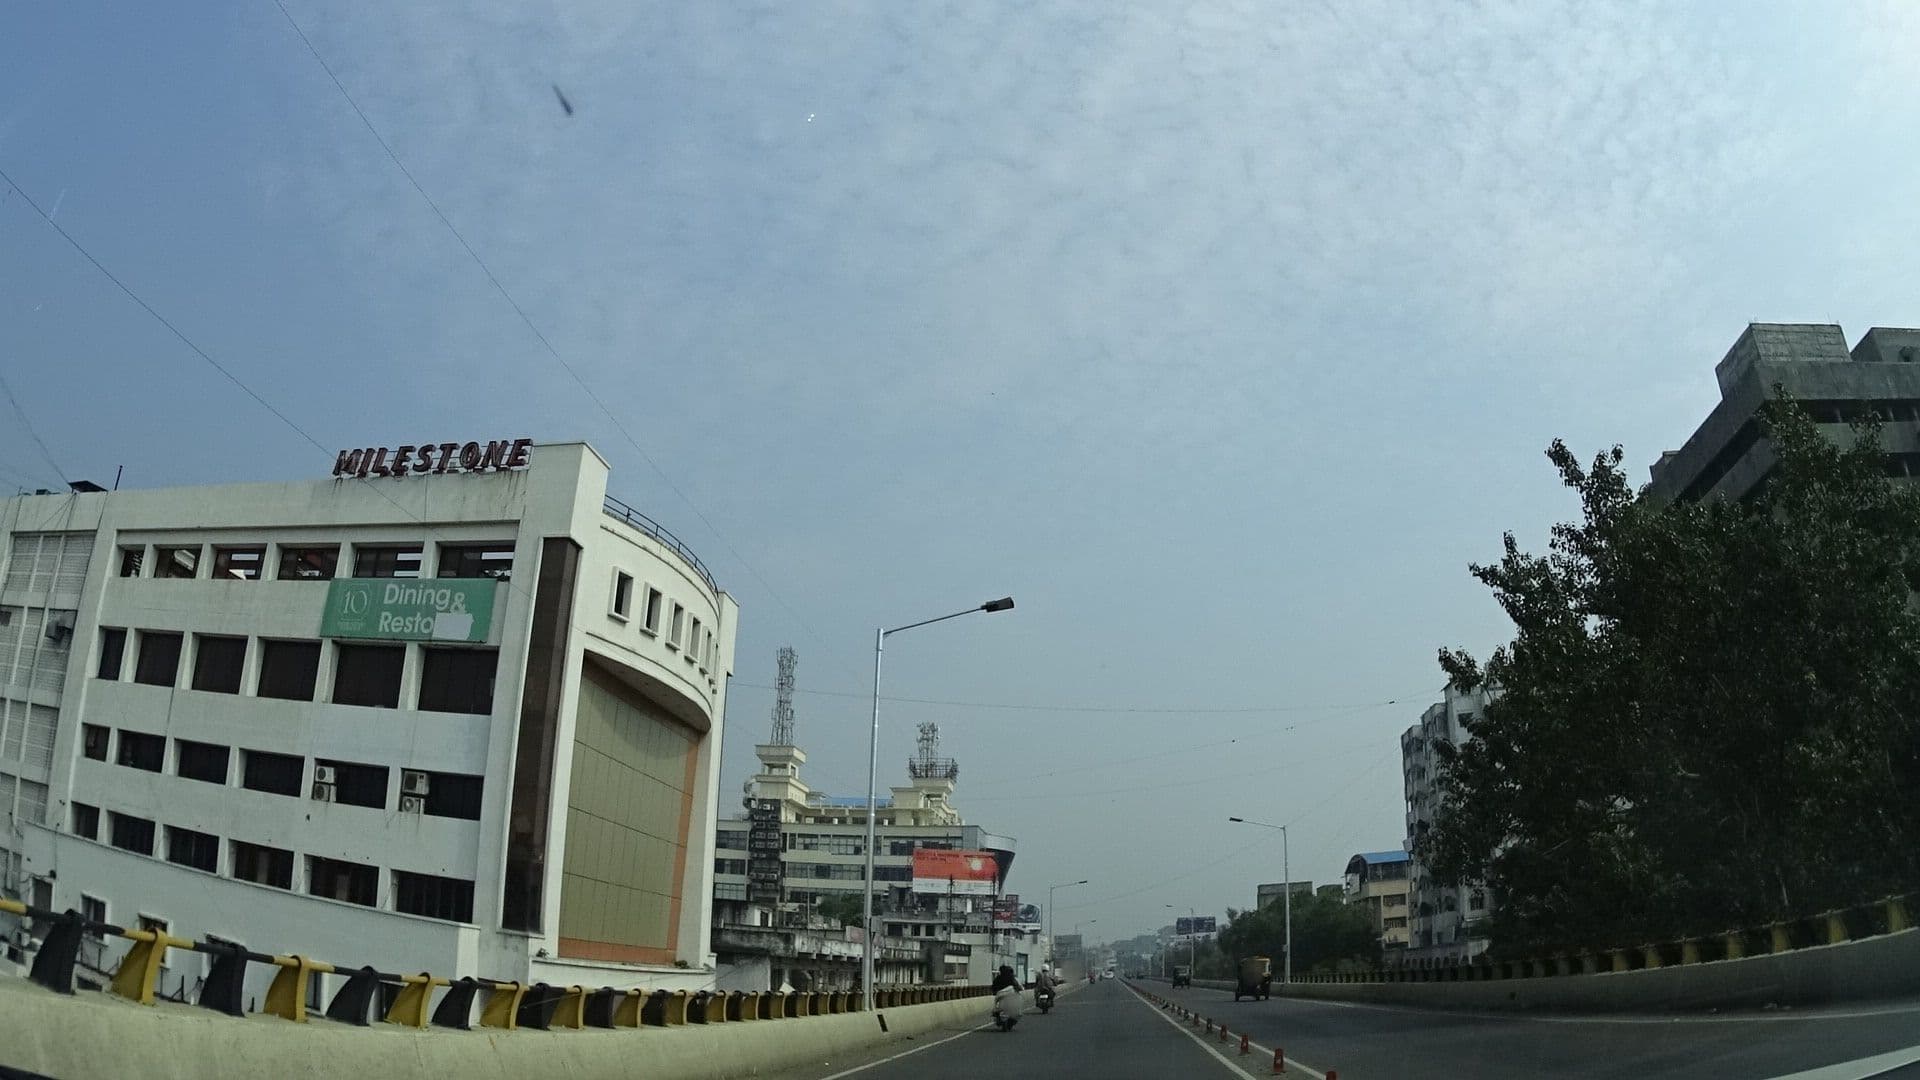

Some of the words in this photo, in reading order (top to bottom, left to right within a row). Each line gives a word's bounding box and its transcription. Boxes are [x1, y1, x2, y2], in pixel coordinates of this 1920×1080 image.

[332, 438, 534, 477] MILESTONE
[383, 583, 451, 611] Dining
[450, 592, 467, 614] &
